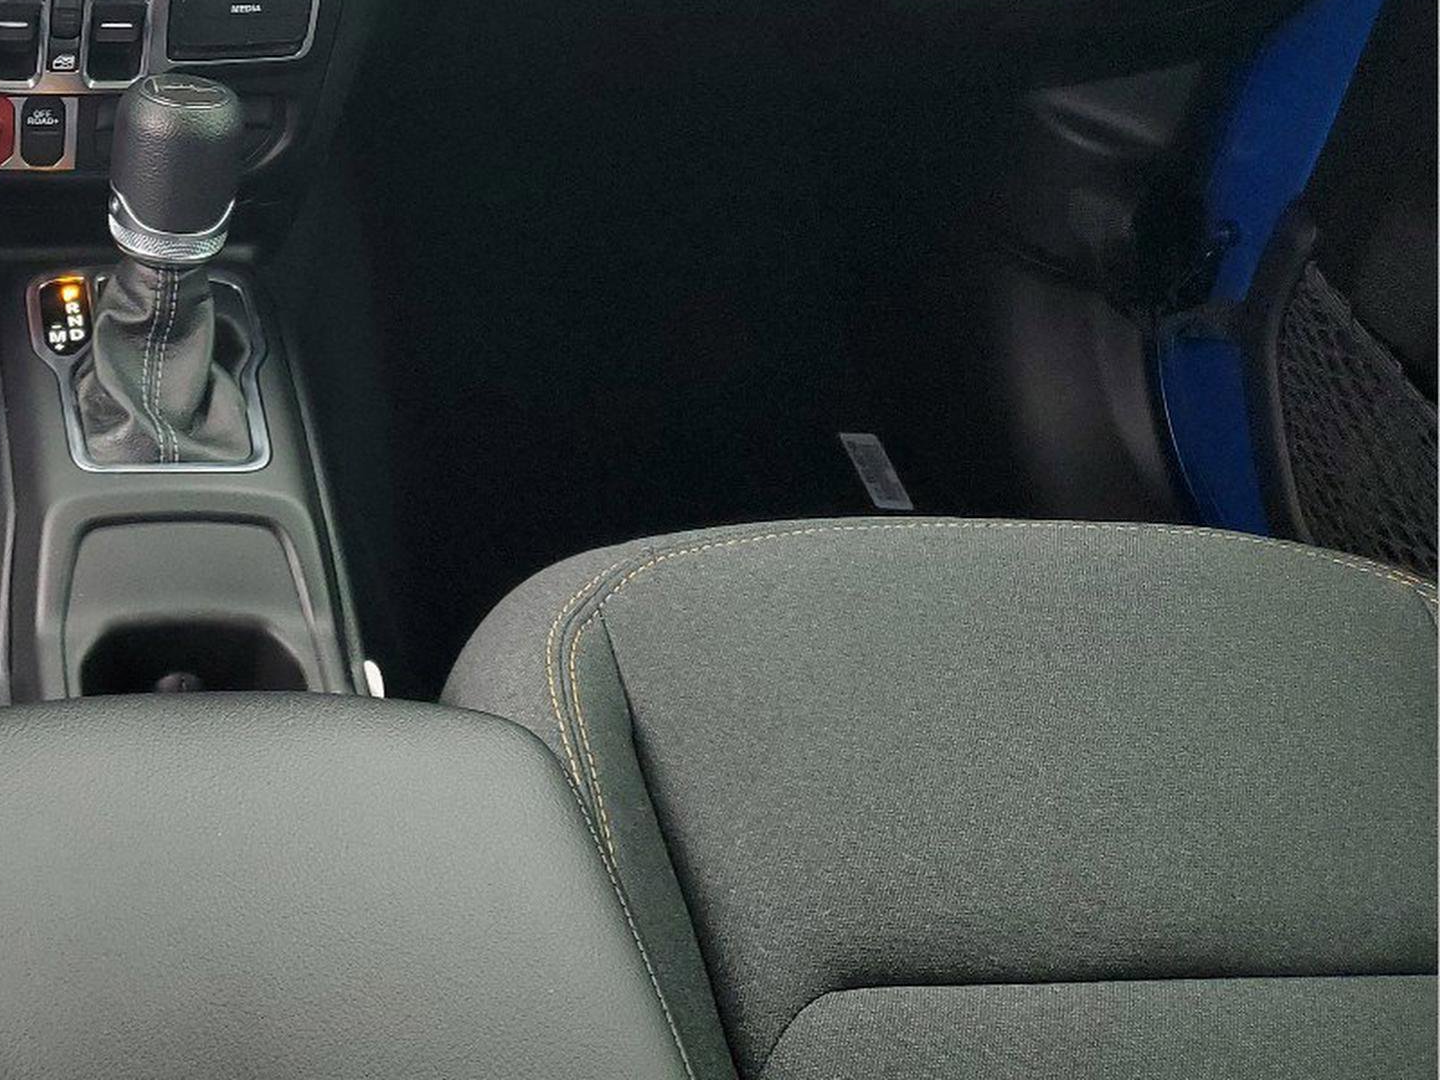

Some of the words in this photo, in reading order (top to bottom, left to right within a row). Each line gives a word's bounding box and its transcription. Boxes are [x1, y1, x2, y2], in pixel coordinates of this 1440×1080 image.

[230, 4, 261, 13] MEDIA
[33, 109, 52, 118] OFF
[67, 314, 84, 327] N
[48, 330, 67, 343] M
[69, 328, 85, 341] D
